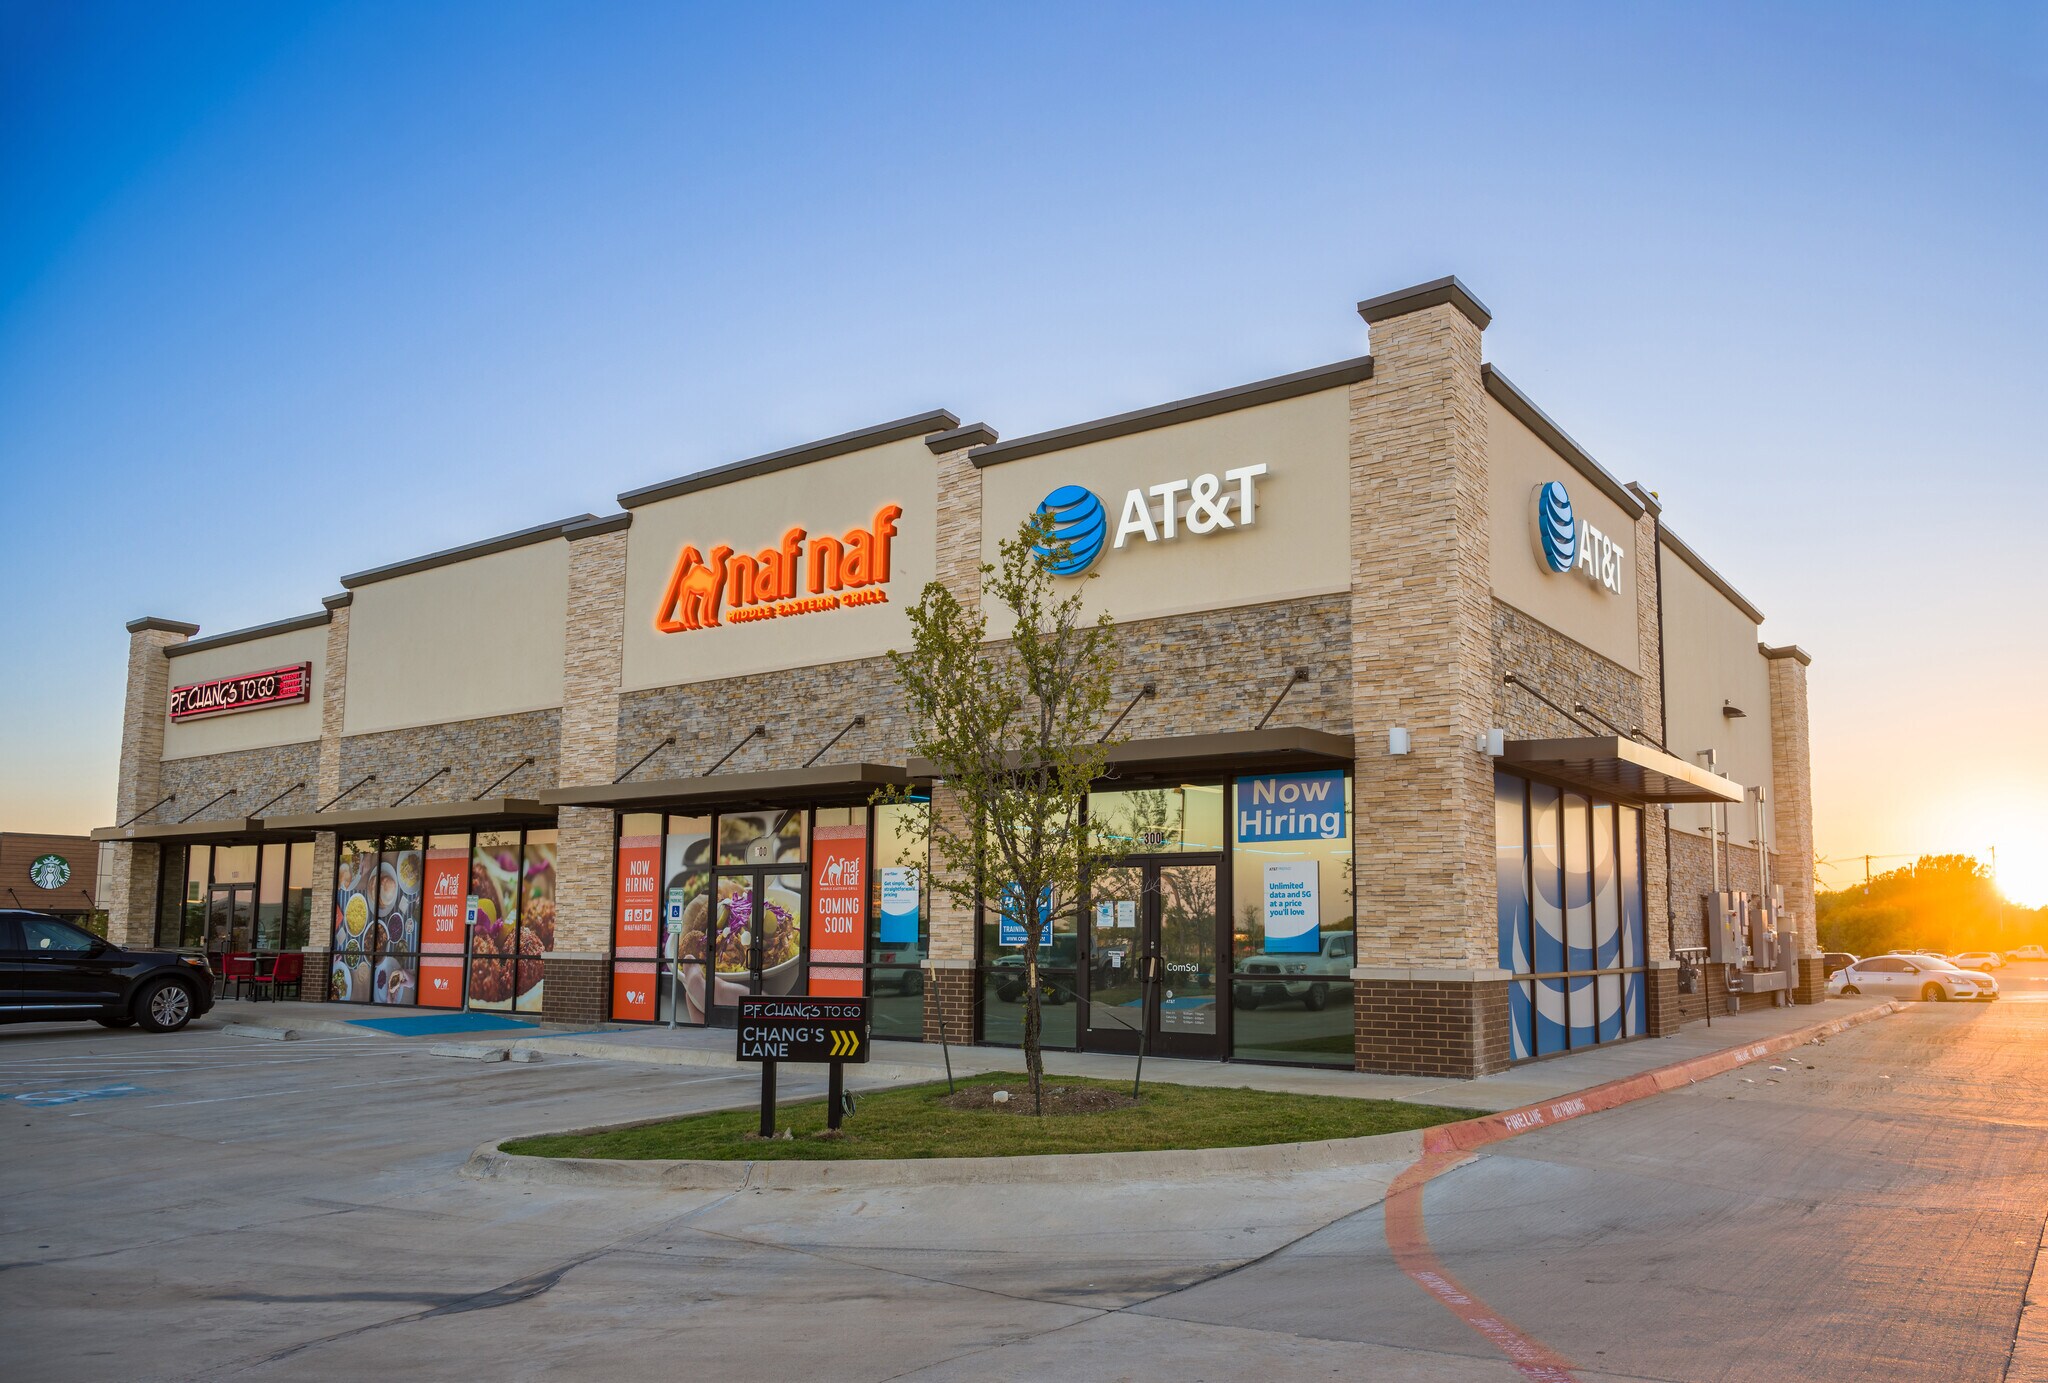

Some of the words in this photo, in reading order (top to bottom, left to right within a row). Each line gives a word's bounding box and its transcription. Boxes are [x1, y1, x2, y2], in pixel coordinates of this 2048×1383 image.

[1113, 462, 1268, 549] AT&T
[727, 527, 807, 607] naf
[807, 504, 903, 594] naf
[1578, 519, 1624, 595] AT&T
[726, 607, 776, 624] MIDDLE
[775, 597, 840, 618] EASTERN
[839, 588, 889, 608] GRILL
[170, 691, 187, 716] P.F.
[187, 681, 238, 709] CHANG'S
[240, 680, 256, 700] TO
[257, 676, 275, 697] GO
[1252, 778, 1331, 805] Now
[1239, 808, 1341, 839] Hiring
[630, 860, 650, 875] NOW
[844, 857, 859, 873] naf
[625, 877, 654, 892] HIRING
[843, 870, 859, 885] naf
[1269, 882, 1304, 890] Unlimited
[433, 904, 458, 917] COMING
[819, 897, 859, 914] COMING
[1284, 899, 1302, 908] price
[1269, 908, 1288, 917] you'll
[436, 919, 454, 931] SOON
[825, 916, 853, 933] SOON
[1166, 962, 1199, 972] ComSol
[743, 1004, 762, 1019] P.F.
[764, 1003, 821, 1020] CHANG'S
[824, 1005, 840, 1017] TO
[843, 1006, 861, 1018] GO
[743, 1026, 825, 1042] CHANG'S
[742, 1043, 789, 1057] LANE
[1503, 1112, 1526, 1132] FIRE
[1521, 1108, 1544, 1126] LANE
[1551, 1103, 1563, 1119] NO
